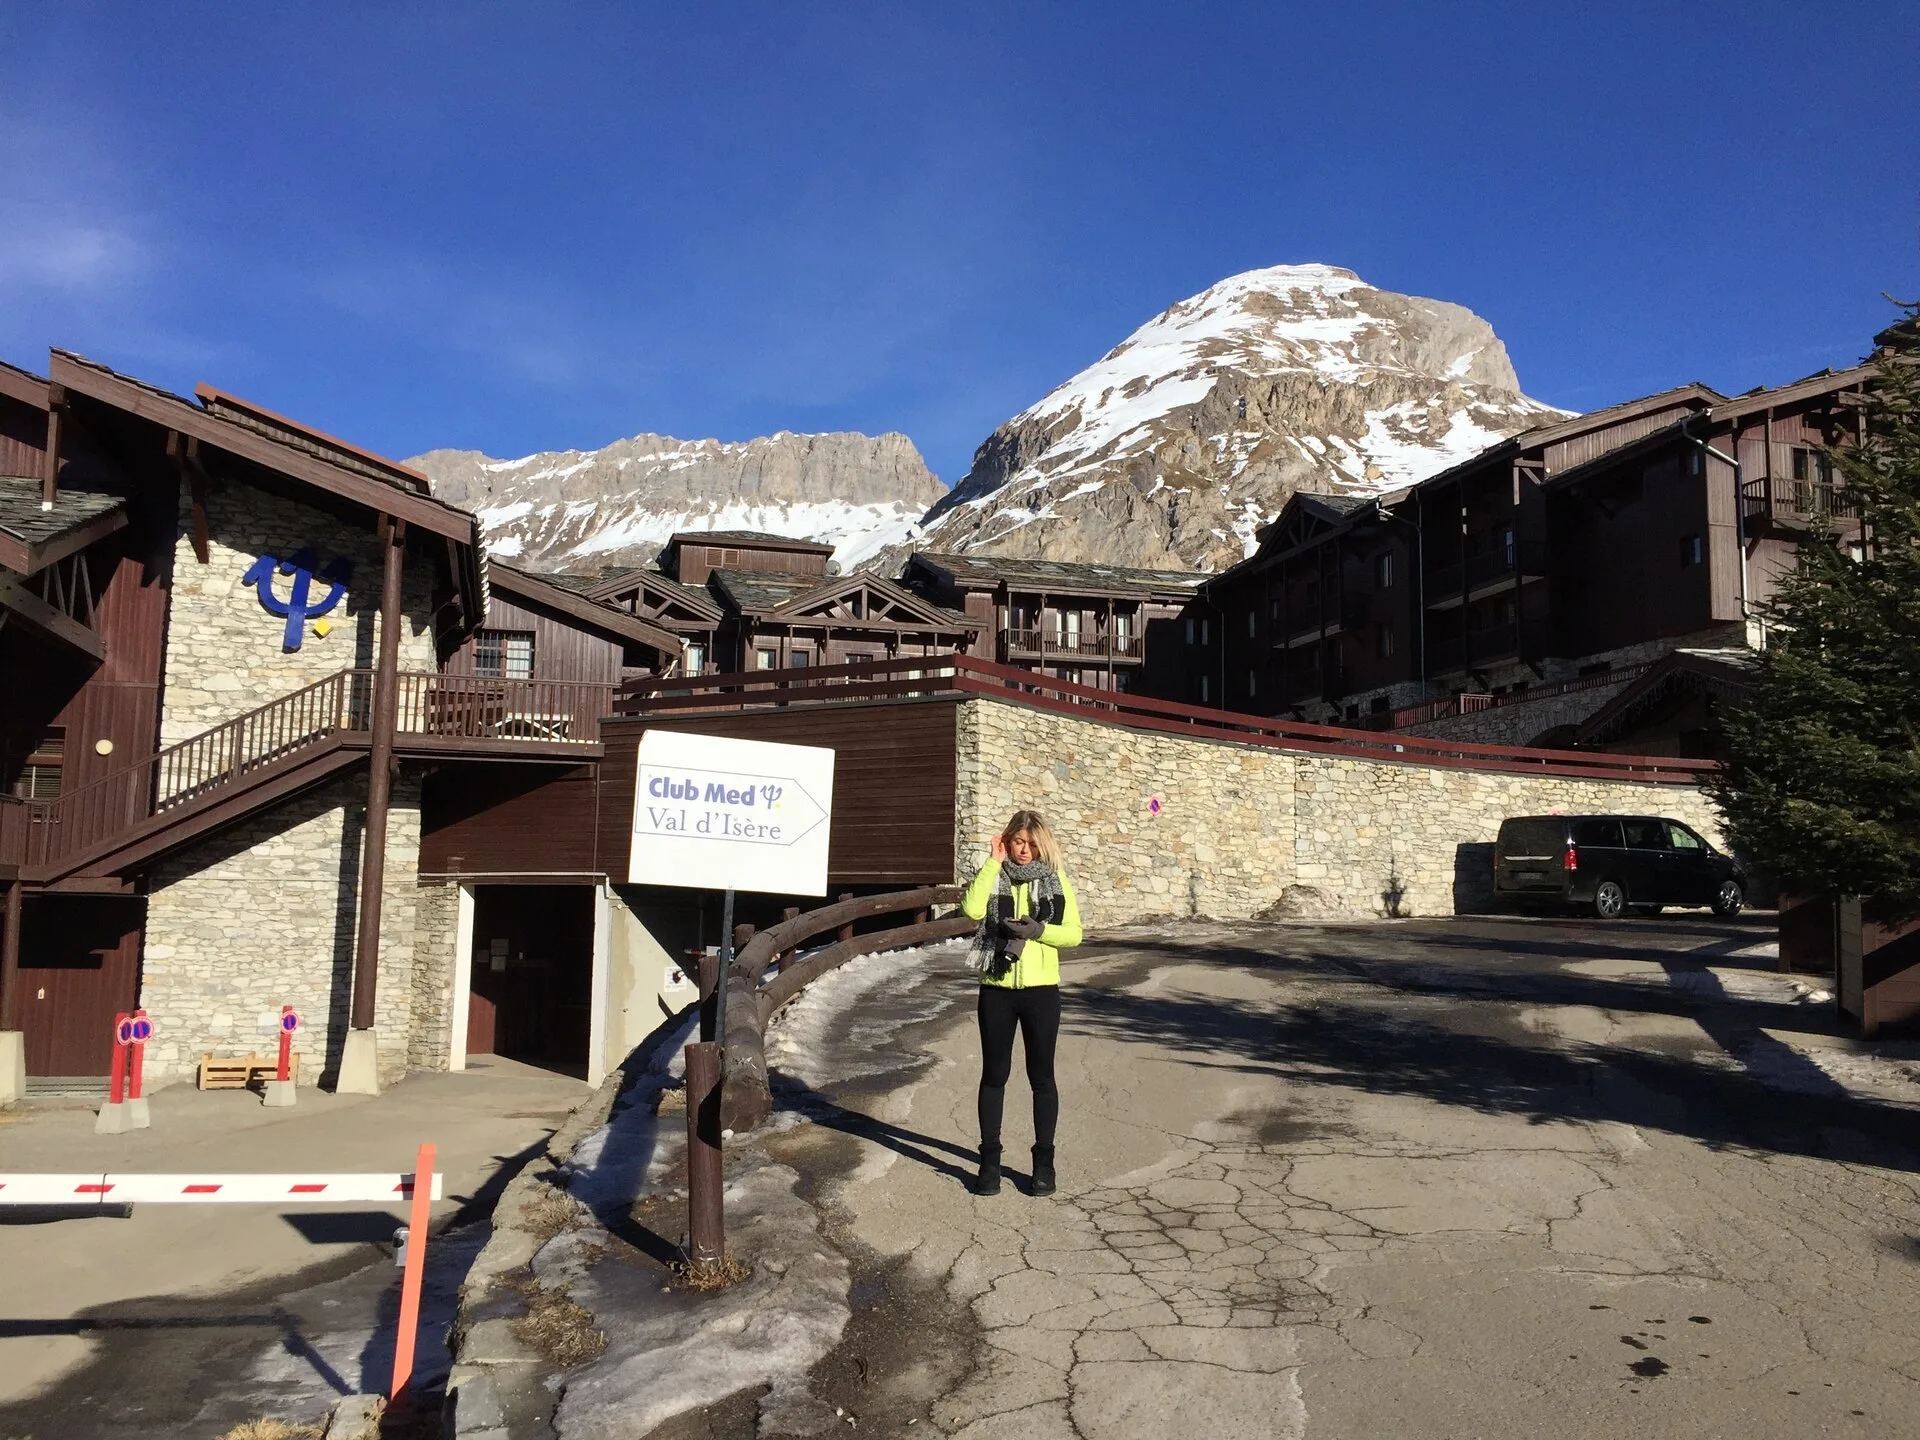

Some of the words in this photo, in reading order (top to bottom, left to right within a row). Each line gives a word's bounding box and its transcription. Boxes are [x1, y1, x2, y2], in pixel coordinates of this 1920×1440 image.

[649, 776, 699, 801] Club
[704, 783, 755, 806] Med
[647, 807, 687, 831] Val
[696, 811, 781, 839] d'Isère
